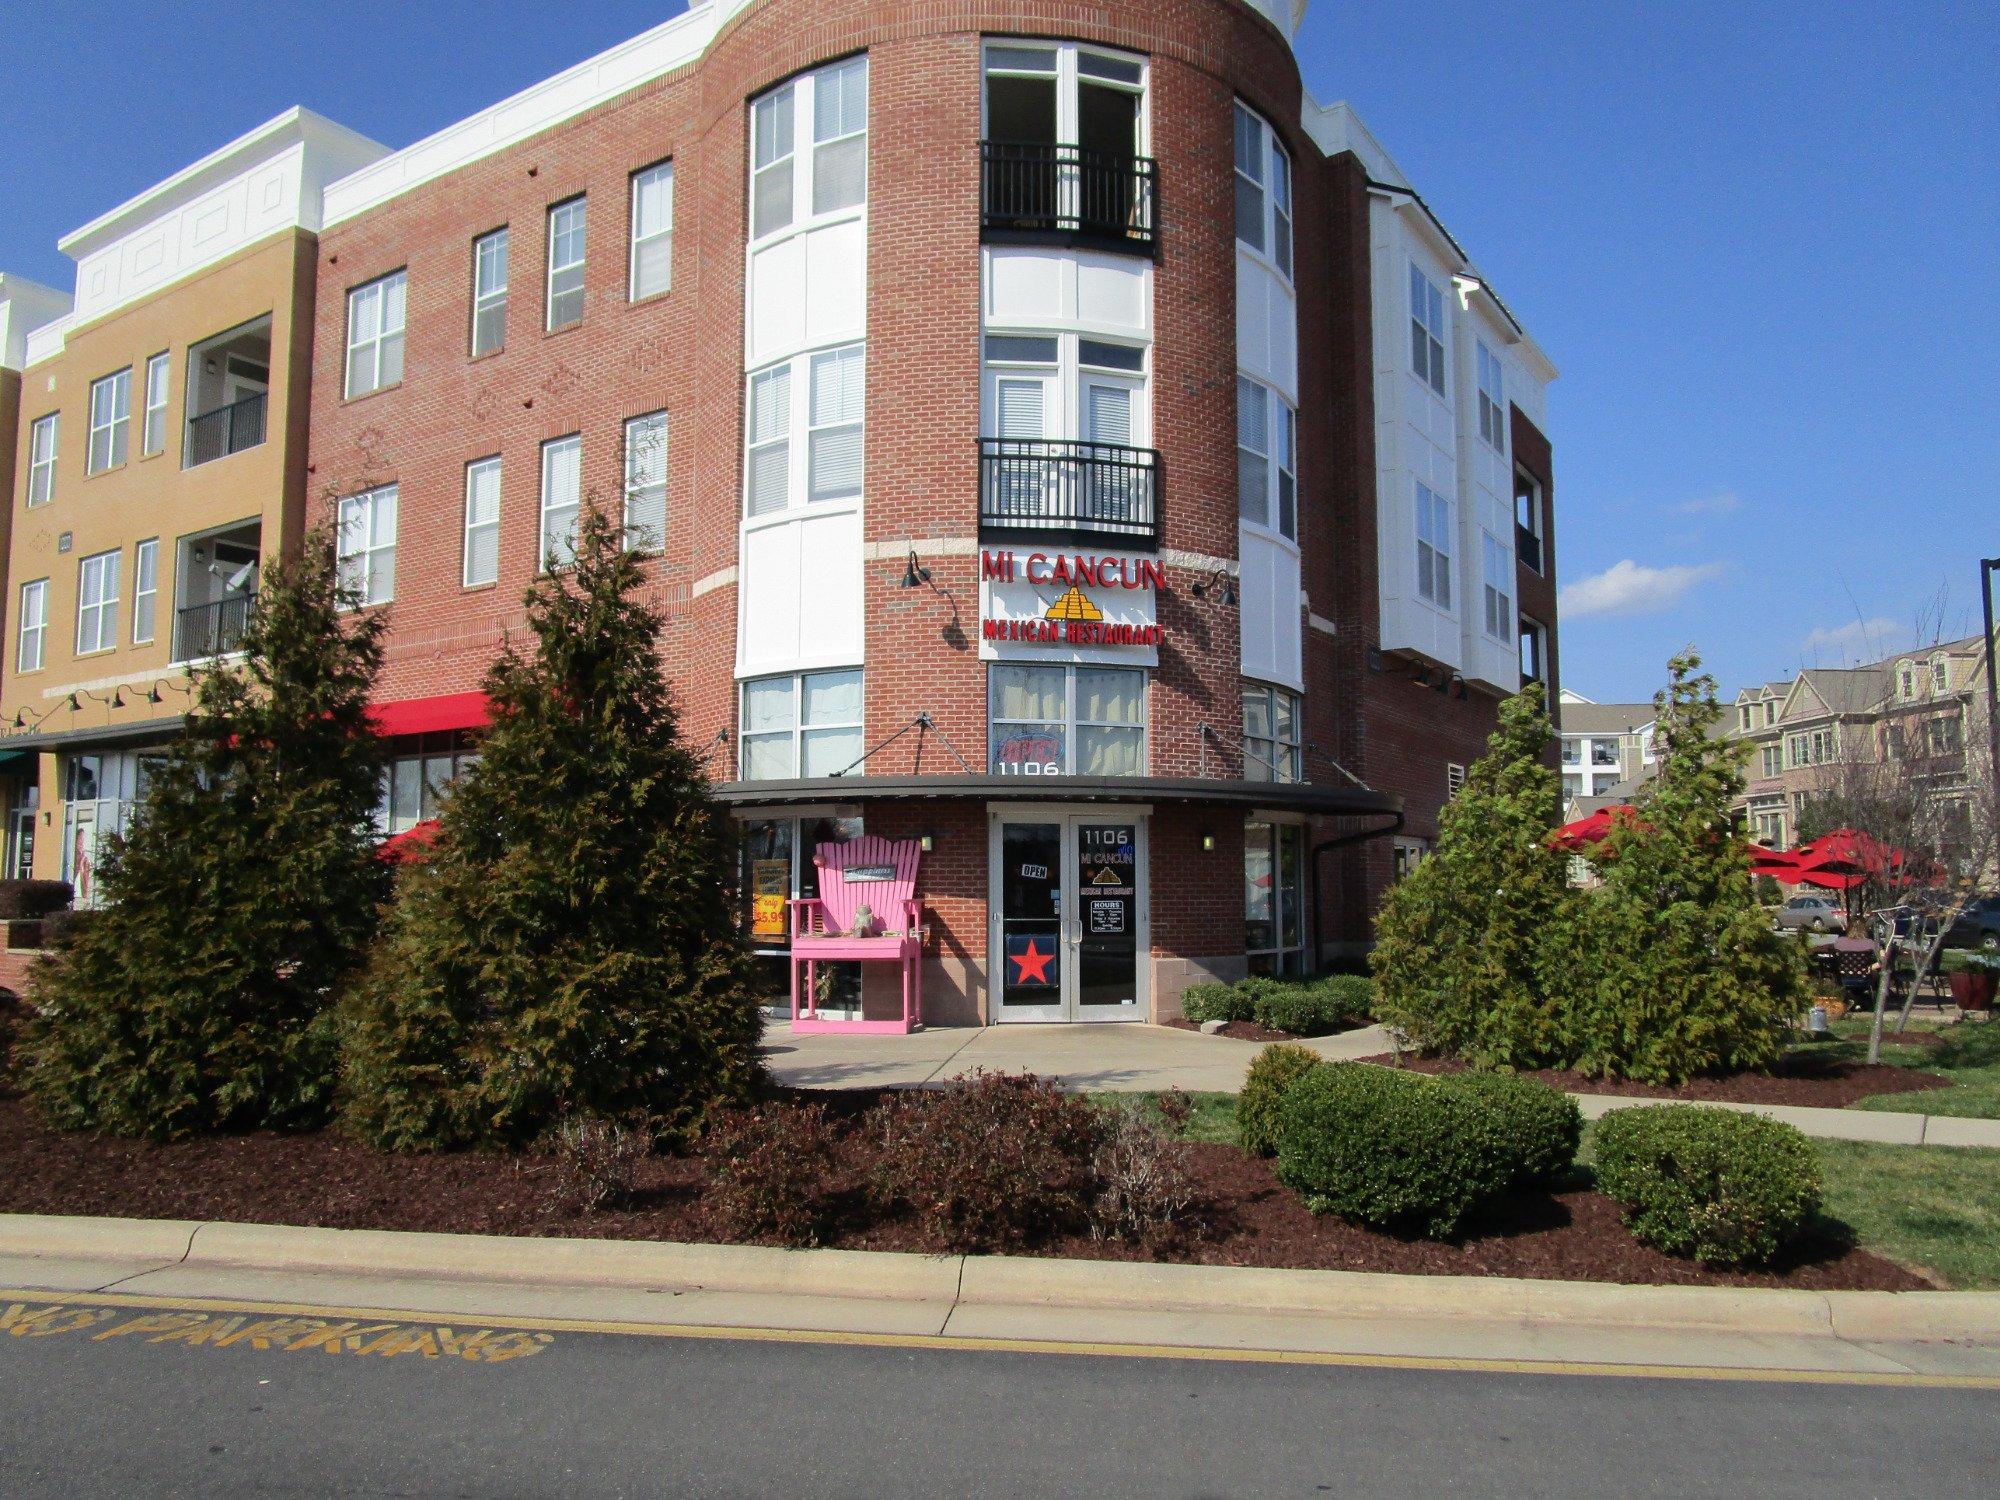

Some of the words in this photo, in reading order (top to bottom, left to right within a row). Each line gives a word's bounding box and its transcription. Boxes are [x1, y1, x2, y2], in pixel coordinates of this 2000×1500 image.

[982, 550, 1014, 583] MI
[1026, 553, 1166, 590] CANCUN
[983, 619, 1059, 642] MEXICAN
[1066, 621, 1164, 646] RESTAURANT
[999, 762, 1059, 776] 1106
[1085, 830, 1128, 845] 1106
[1024, 865, 1046, 878] OPEN
